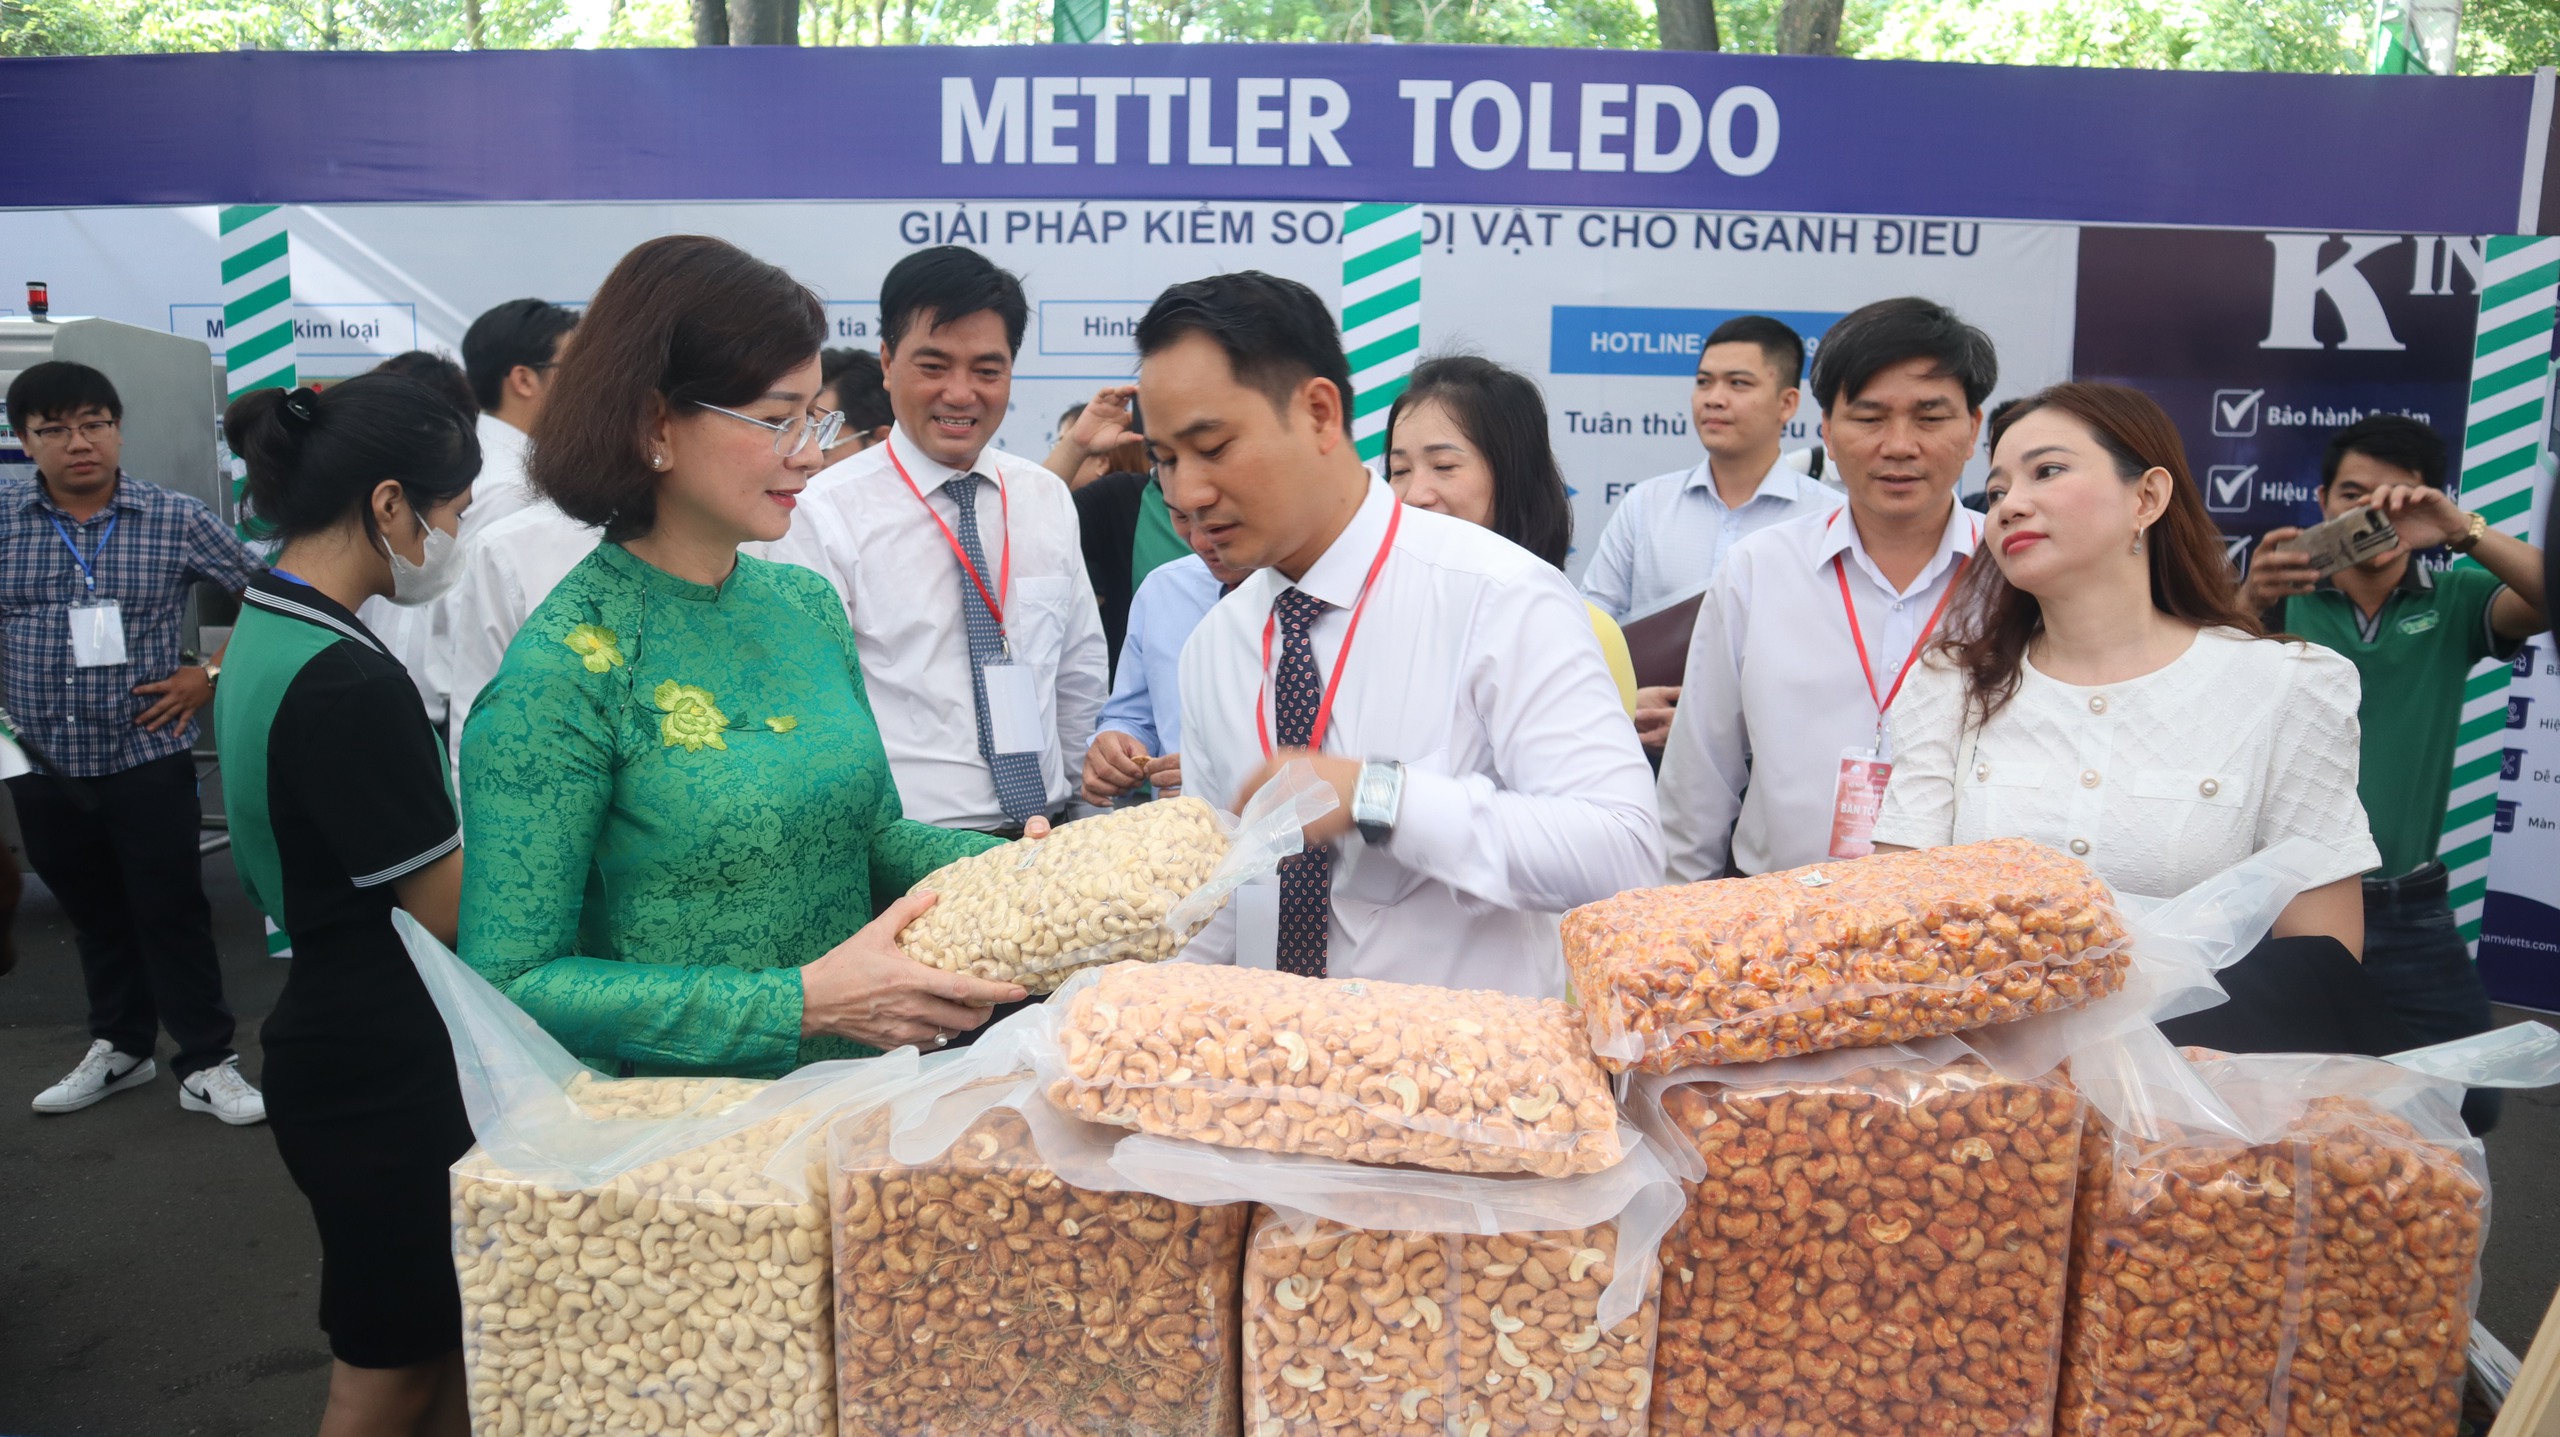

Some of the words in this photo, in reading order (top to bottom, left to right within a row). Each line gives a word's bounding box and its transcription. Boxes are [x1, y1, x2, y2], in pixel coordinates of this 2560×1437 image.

[941, 77, 1352, 166] METTLER
[1399, 79, 1781, 177] TOLEDO
[900, 202, 987, 244] GIẢI
[1006, 201, 1128, 243] PHÁP
[1271, 210, 1343, 244] SO
[1471, 208, 1563, 255] VẬT
[1578, 213, 1677, 248] CHO
[293, 319, 333, 338] kim
[340, 319, 380, 343] loại
[837, 316, 867, 336] tia
[1564, 411, 1632, 434] Tuân
[1642, 411, 1687, 435] thủ
[2266, 404, 2307, 426] Bảo
[2261, 481, 2309, 506] Hiệu
[2529, 817, 2556, 831] Màn
